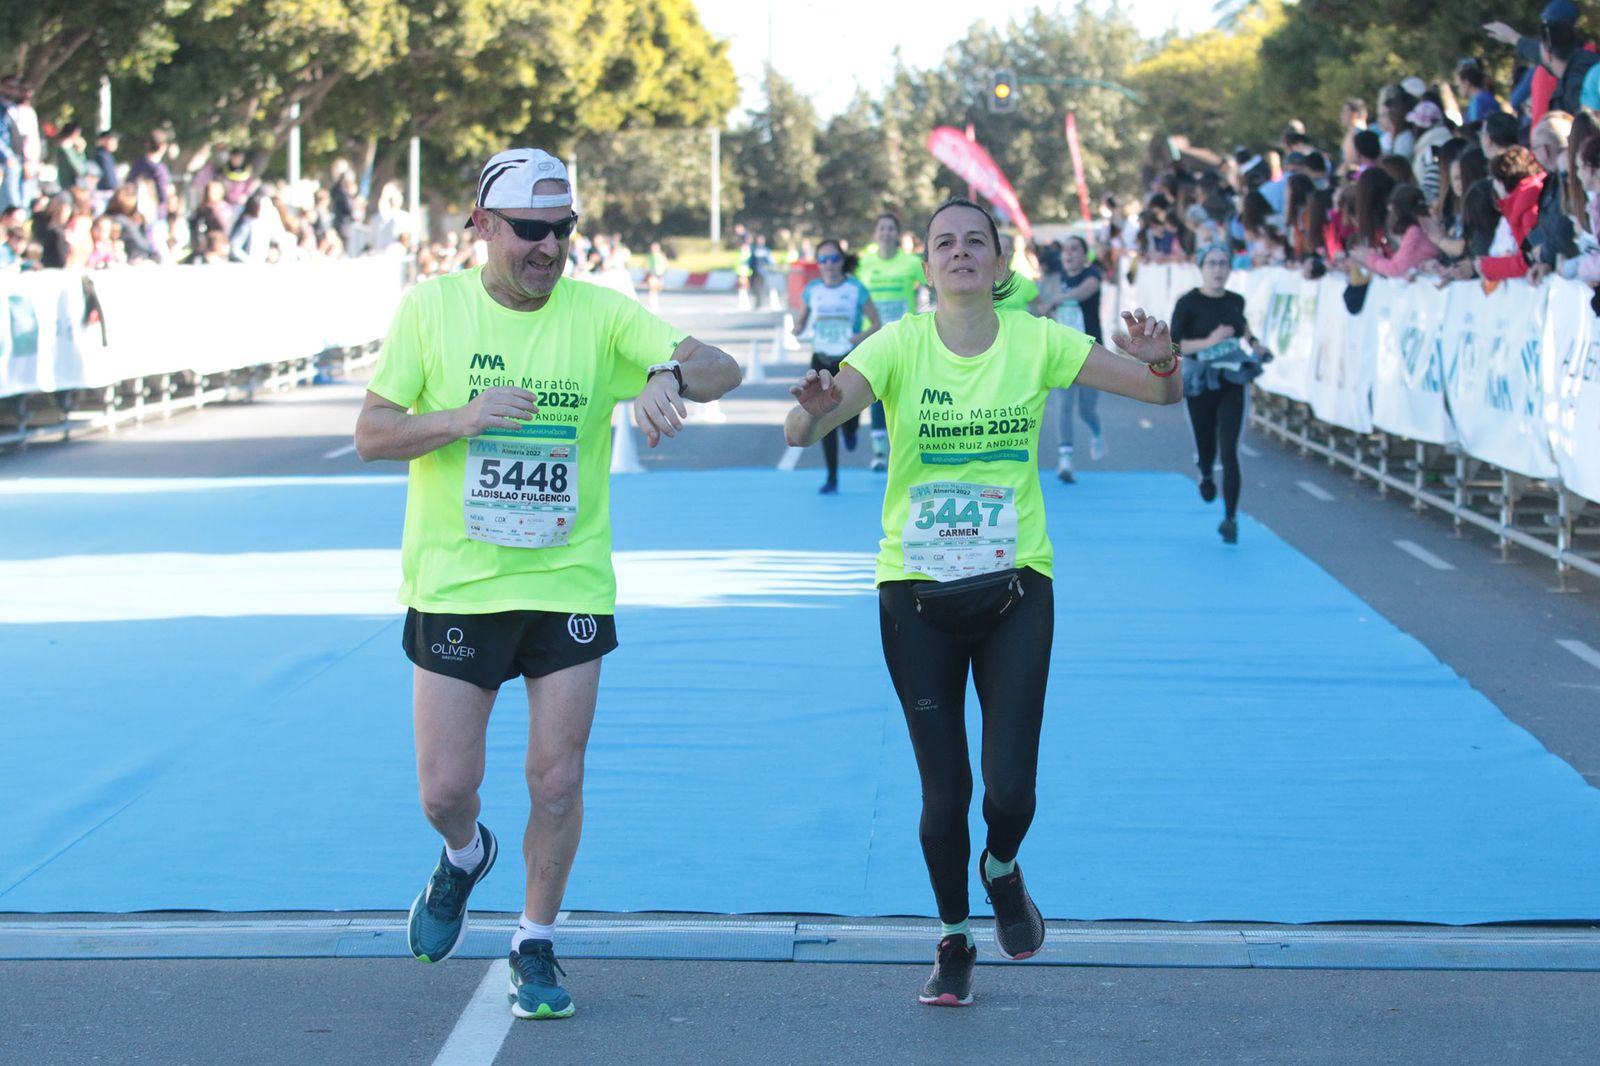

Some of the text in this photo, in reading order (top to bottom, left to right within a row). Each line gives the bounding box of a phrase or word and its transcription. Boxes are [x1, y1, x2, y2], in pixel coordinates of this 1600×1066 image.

[468, 375, 580, 391] Medio Maratón
[535, 413, 579, 423] ANDÚJAR
[919, 405, 1029, 421] Medio Maratón
[918, 421, 984, 438] Almería
[919, 438, 1029, 450] RAMÓN RUIZ ANDÚJAR
[479, 459, 568, 493] 5448
[471, 489, 519, 501] LADISLAO
[521, 492, 571, 503] FULGENCIO
[956, 488, 971, 496] 2022
[915, 498, 1004, 530] 5447
[938, 527, 979, 538] CARMEN
[431, 643, 476, 659] OLIVER
